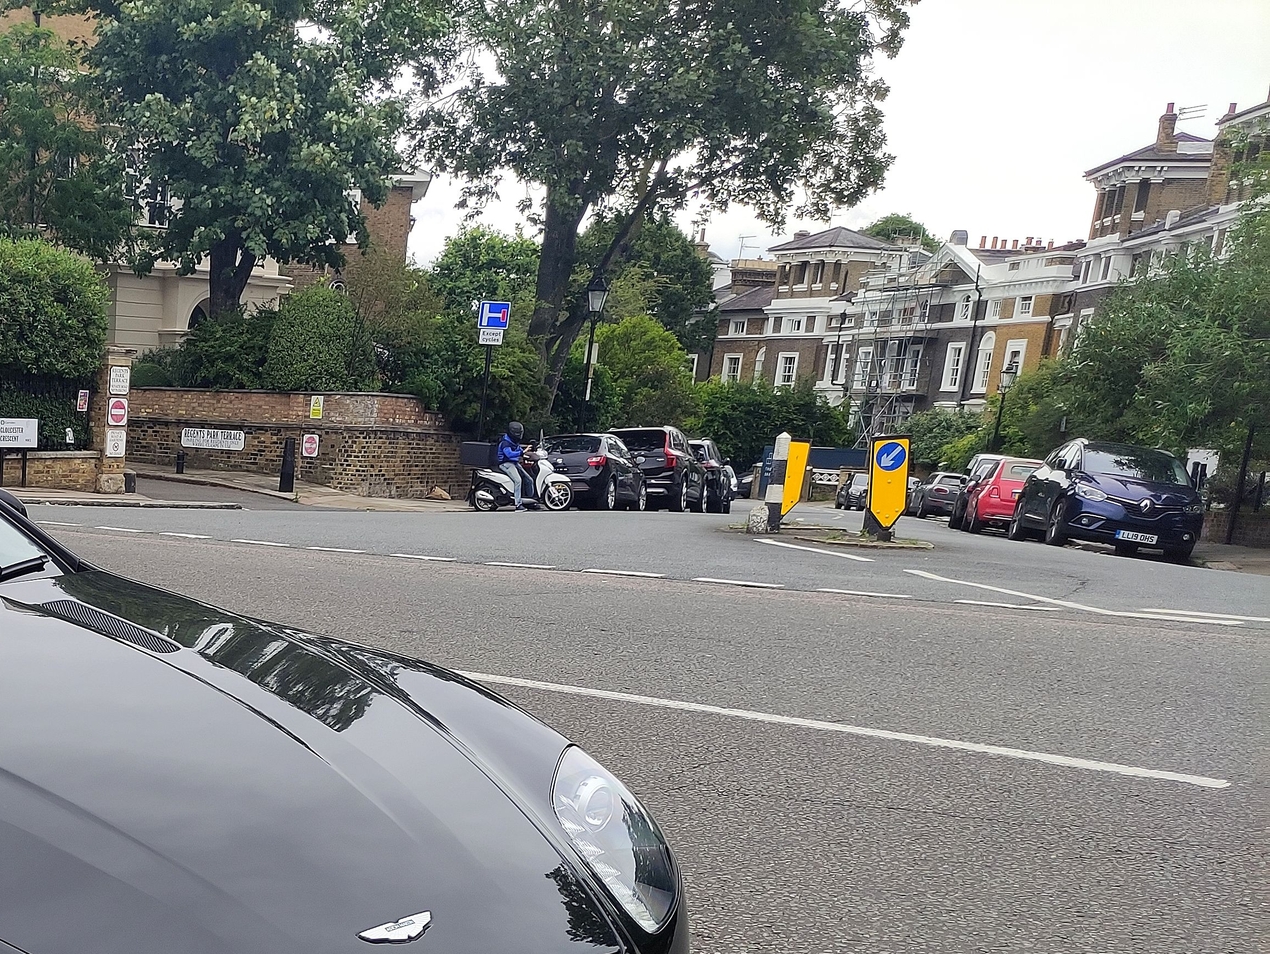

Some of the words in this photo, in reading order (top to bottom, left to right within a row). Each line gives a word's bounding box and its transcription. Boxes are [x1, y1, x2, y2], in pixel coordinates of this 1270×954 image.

[0, 426, 24, 434] GLOUCESTER
[207, 429, 220, 440] PARK
[220, 430, 242, 441] TERRACE
[0, 435, 20, 443] CRESCENT
[1121, 531, 1139, 541] LL19
[1139, 534, 1155, 543] OHS
